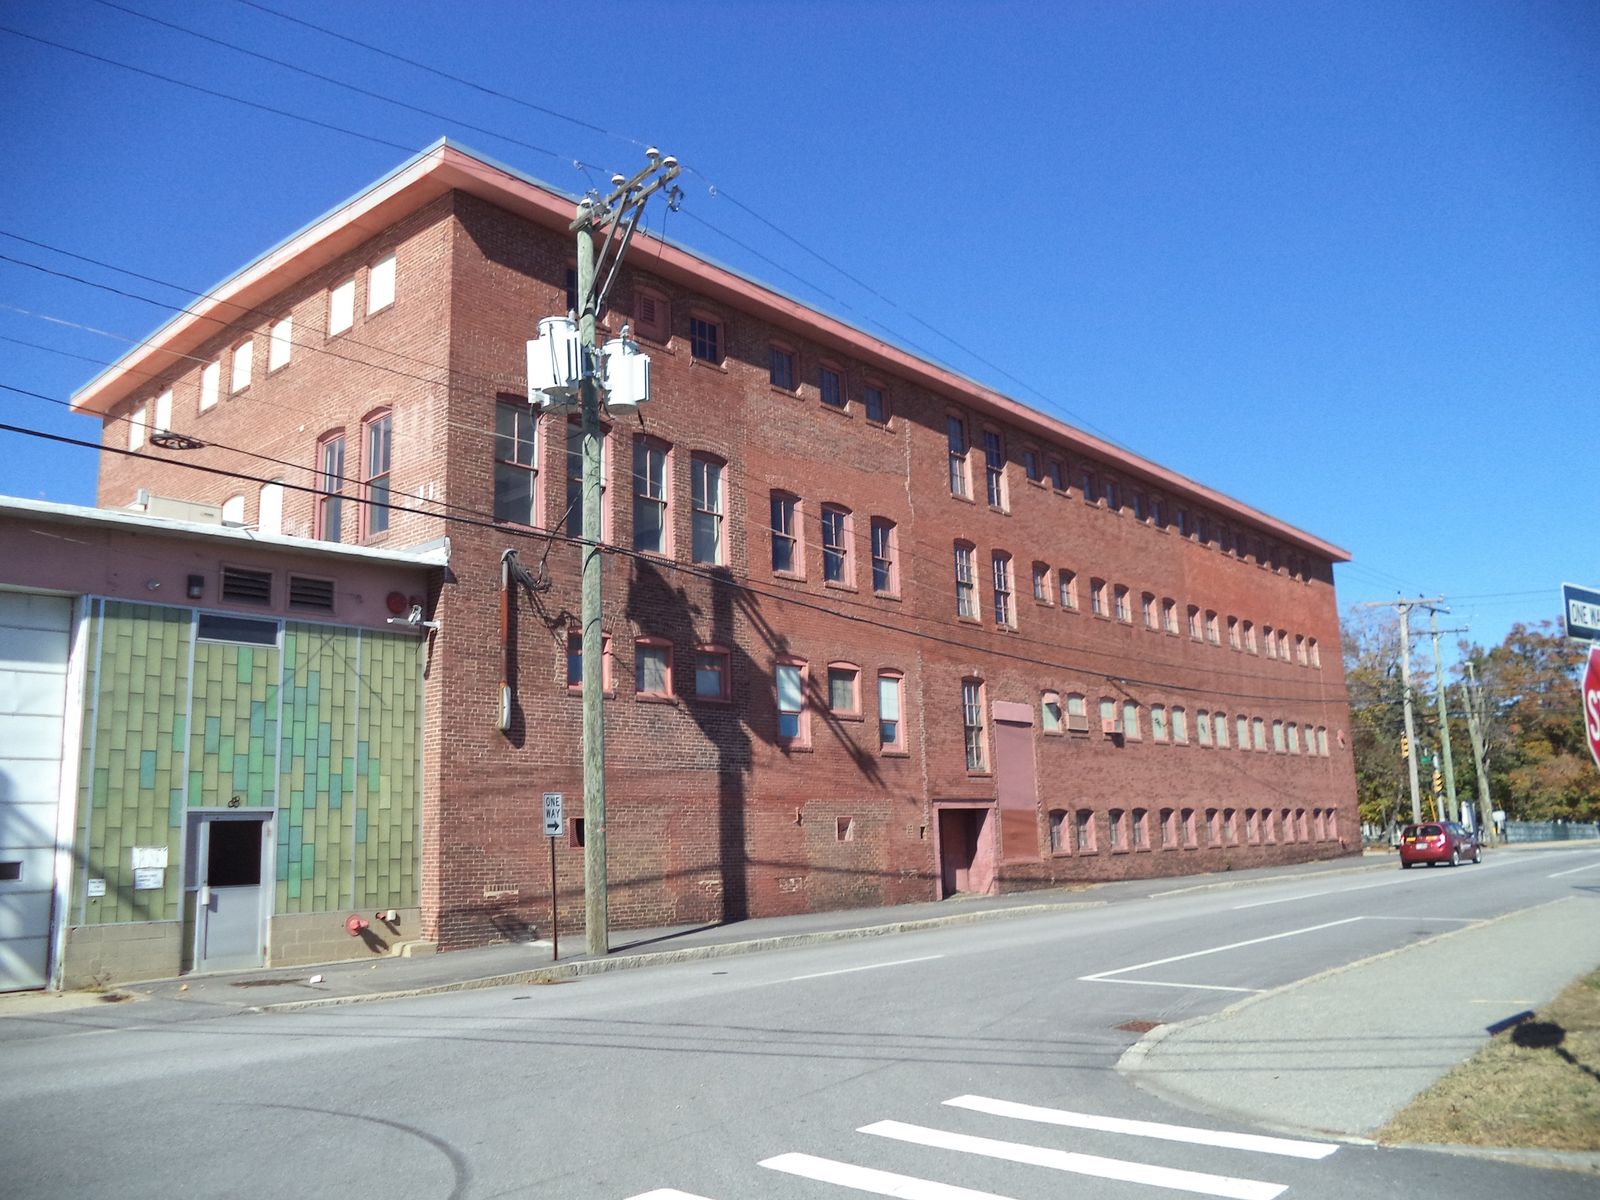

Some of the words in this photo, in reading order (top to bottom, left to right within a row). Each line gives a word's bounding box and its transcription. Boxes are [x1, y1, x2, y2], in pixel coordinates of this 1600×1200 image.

[1571, 602, 1588, 625] ONE
[1588, 690, 1600, 741] S
[545, 796, 560, 807] ONE
[546, 808, 560, 818] WAY
